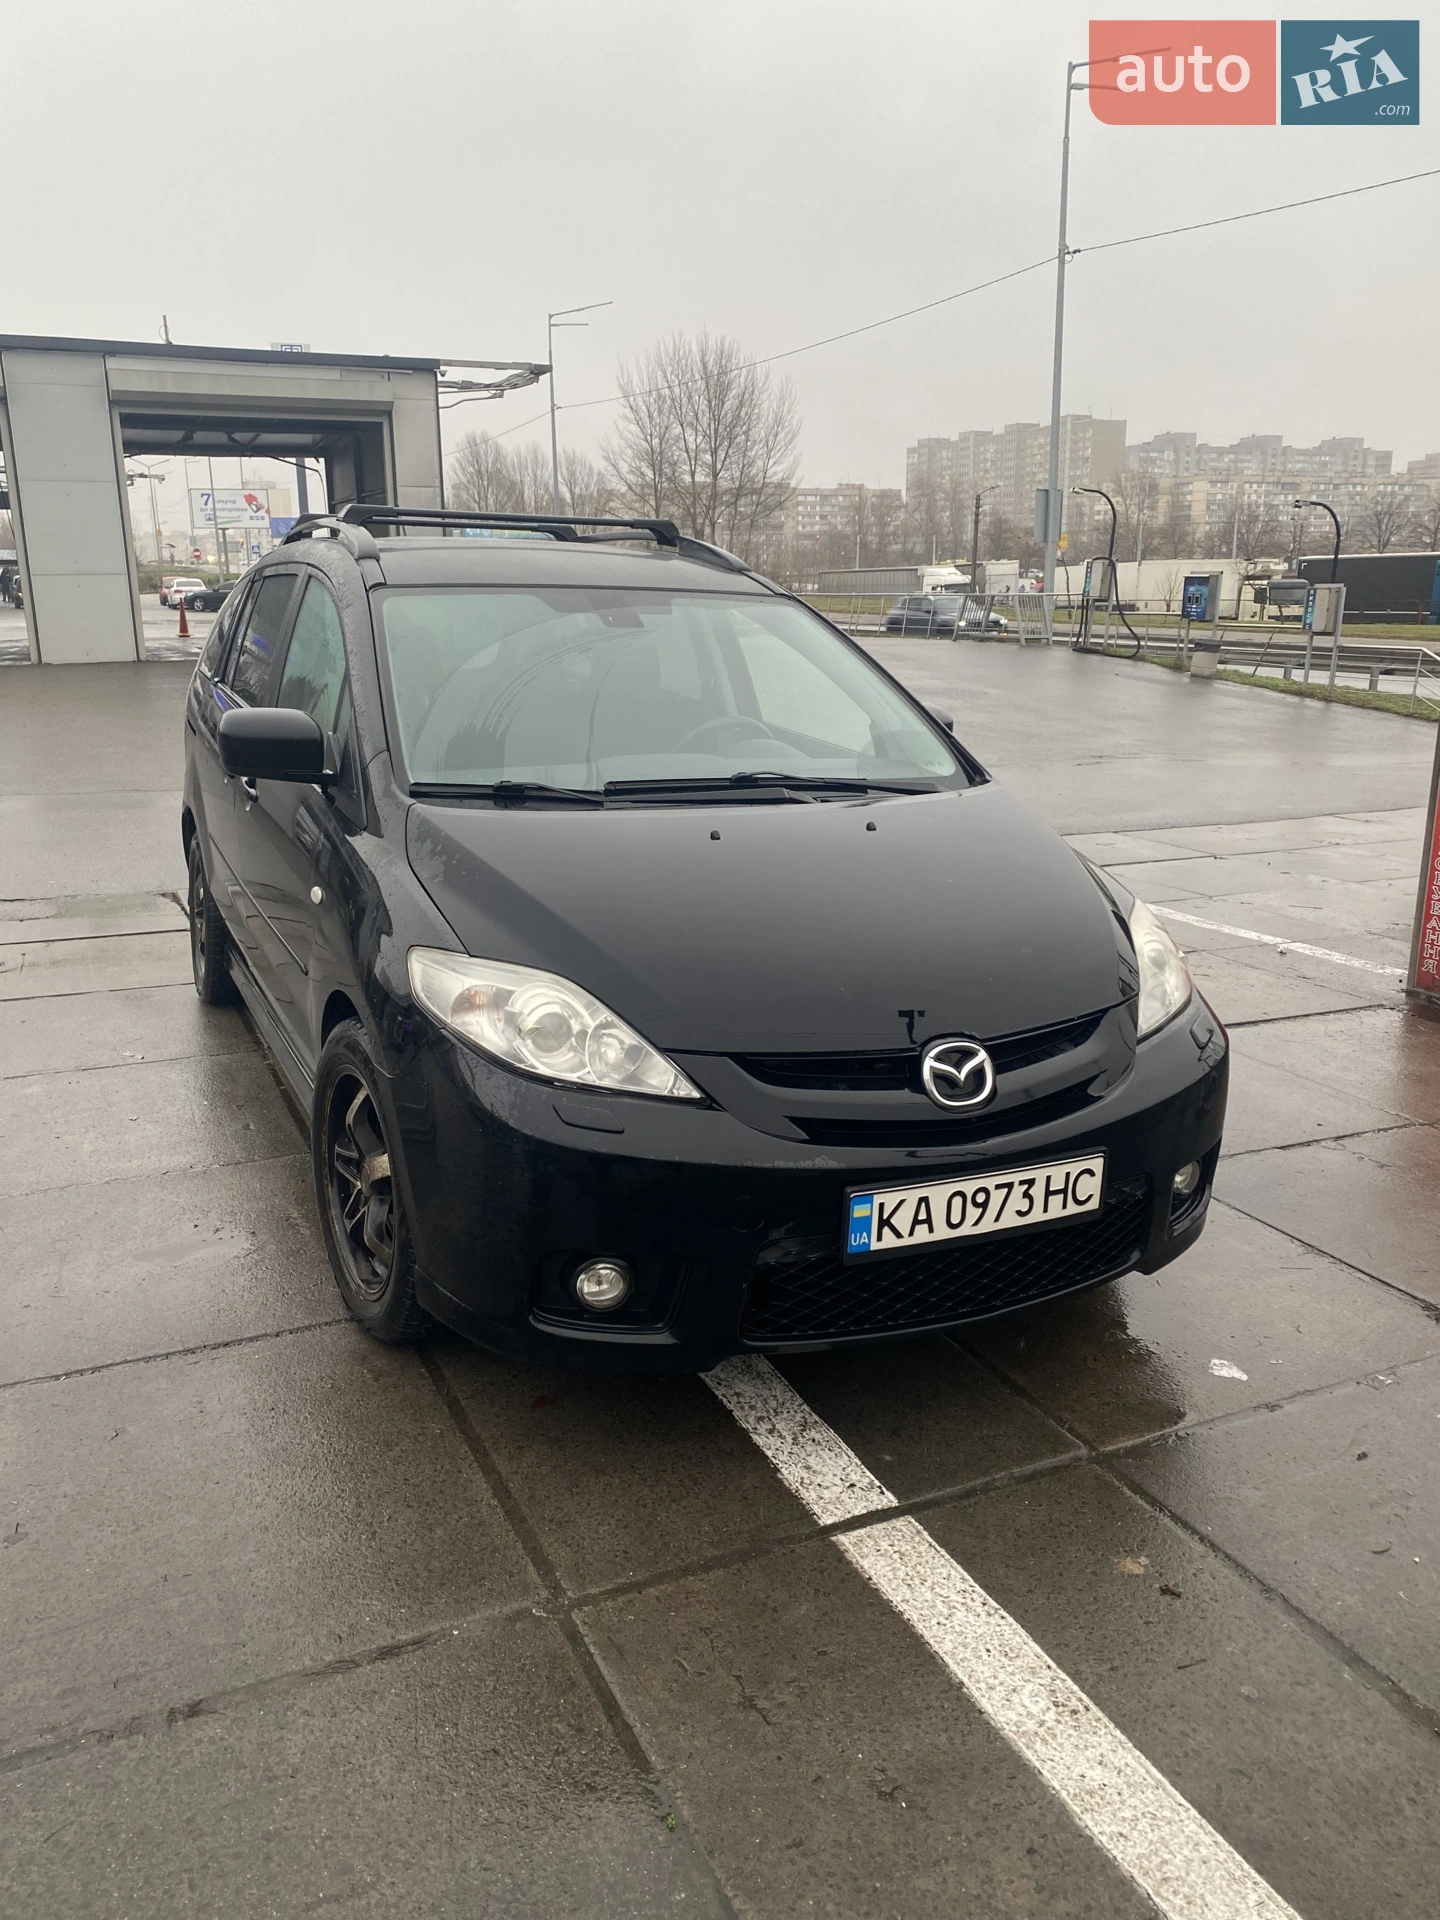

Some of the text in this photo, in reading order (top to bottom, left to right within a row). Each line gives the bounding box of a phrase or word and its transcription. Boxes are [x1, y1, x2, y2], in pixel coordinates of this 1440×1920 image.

[200, 493, 211, 506] 7
[1305, 589, 1315, 630] ПИЛОСОС
[876, 1167, 1097, 1243] KA 0973 HC
[851, 1232, 869, 1246] UA
